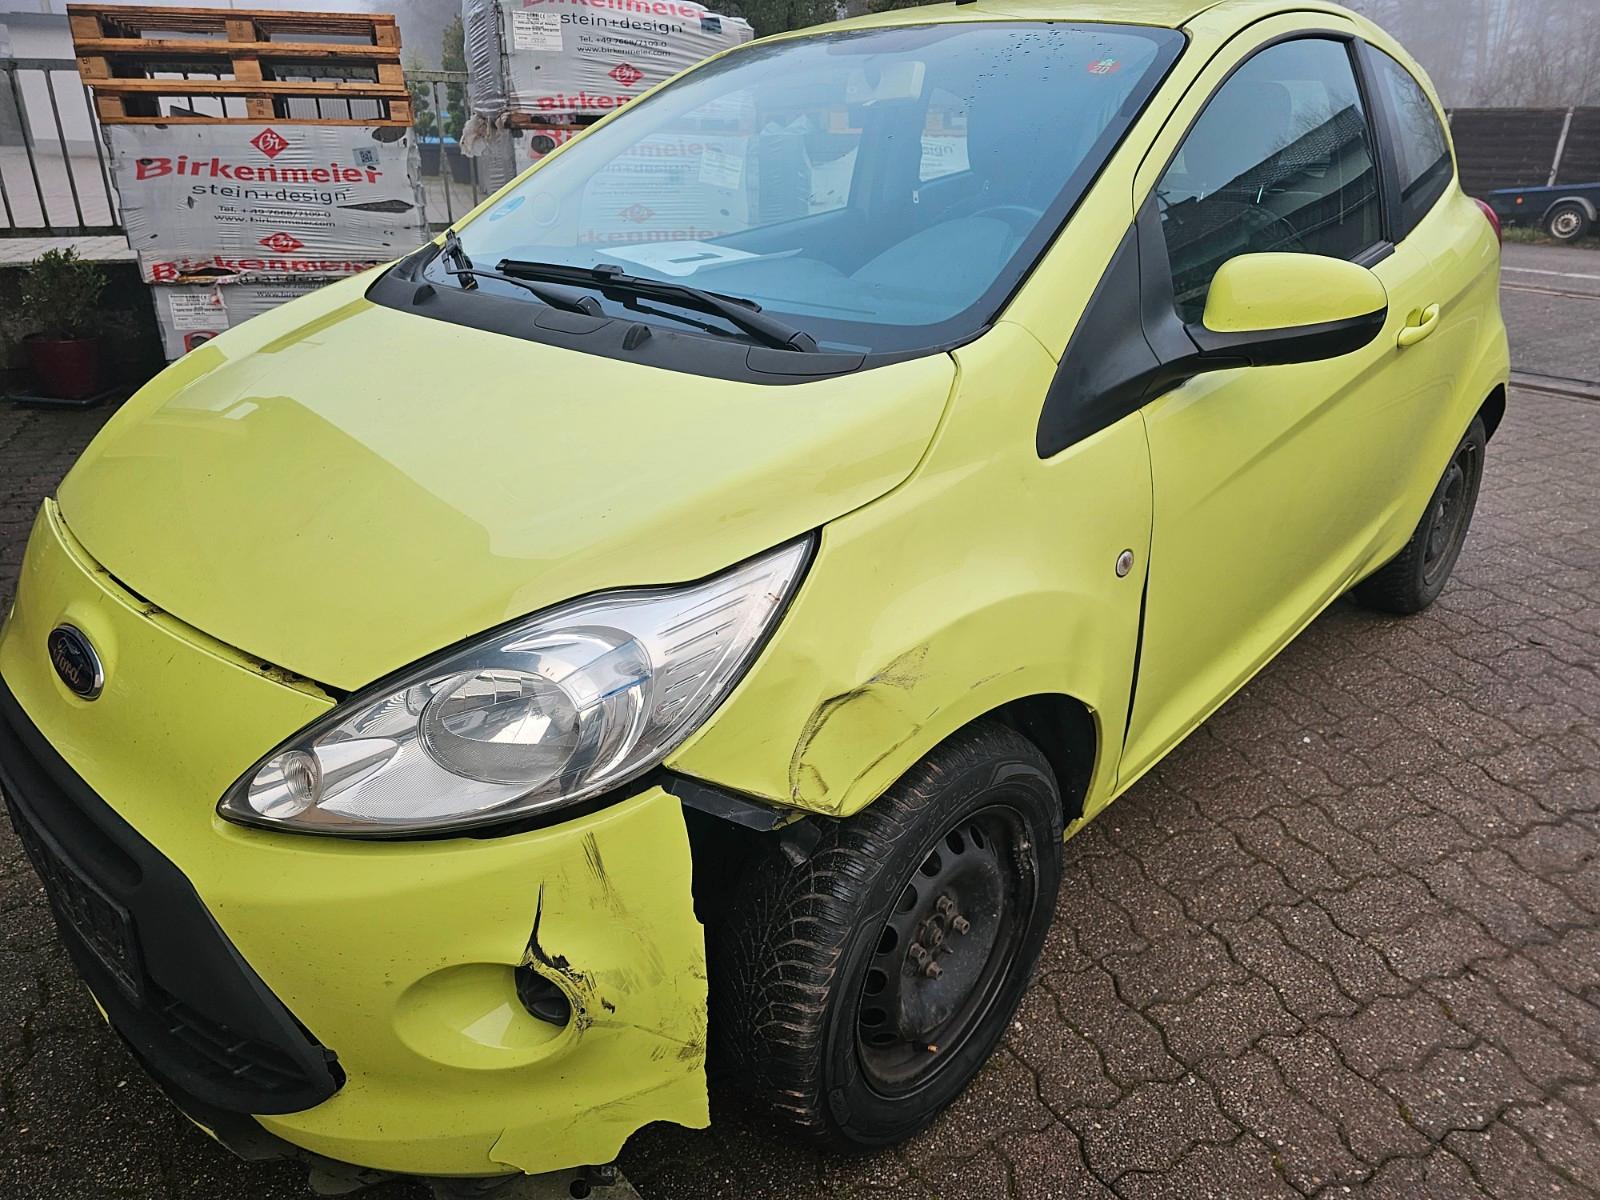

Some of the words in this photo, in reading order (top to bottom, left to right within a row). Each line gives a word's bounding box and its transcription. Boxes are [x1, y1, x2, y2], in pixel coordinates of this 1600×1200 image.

[560, 12, 683, 34] stein+design
[579, 35, 593, 43] Tel.
[135, 155, 383, 184] Birkenmeier
[192, 184, 347, 205] stein+design
